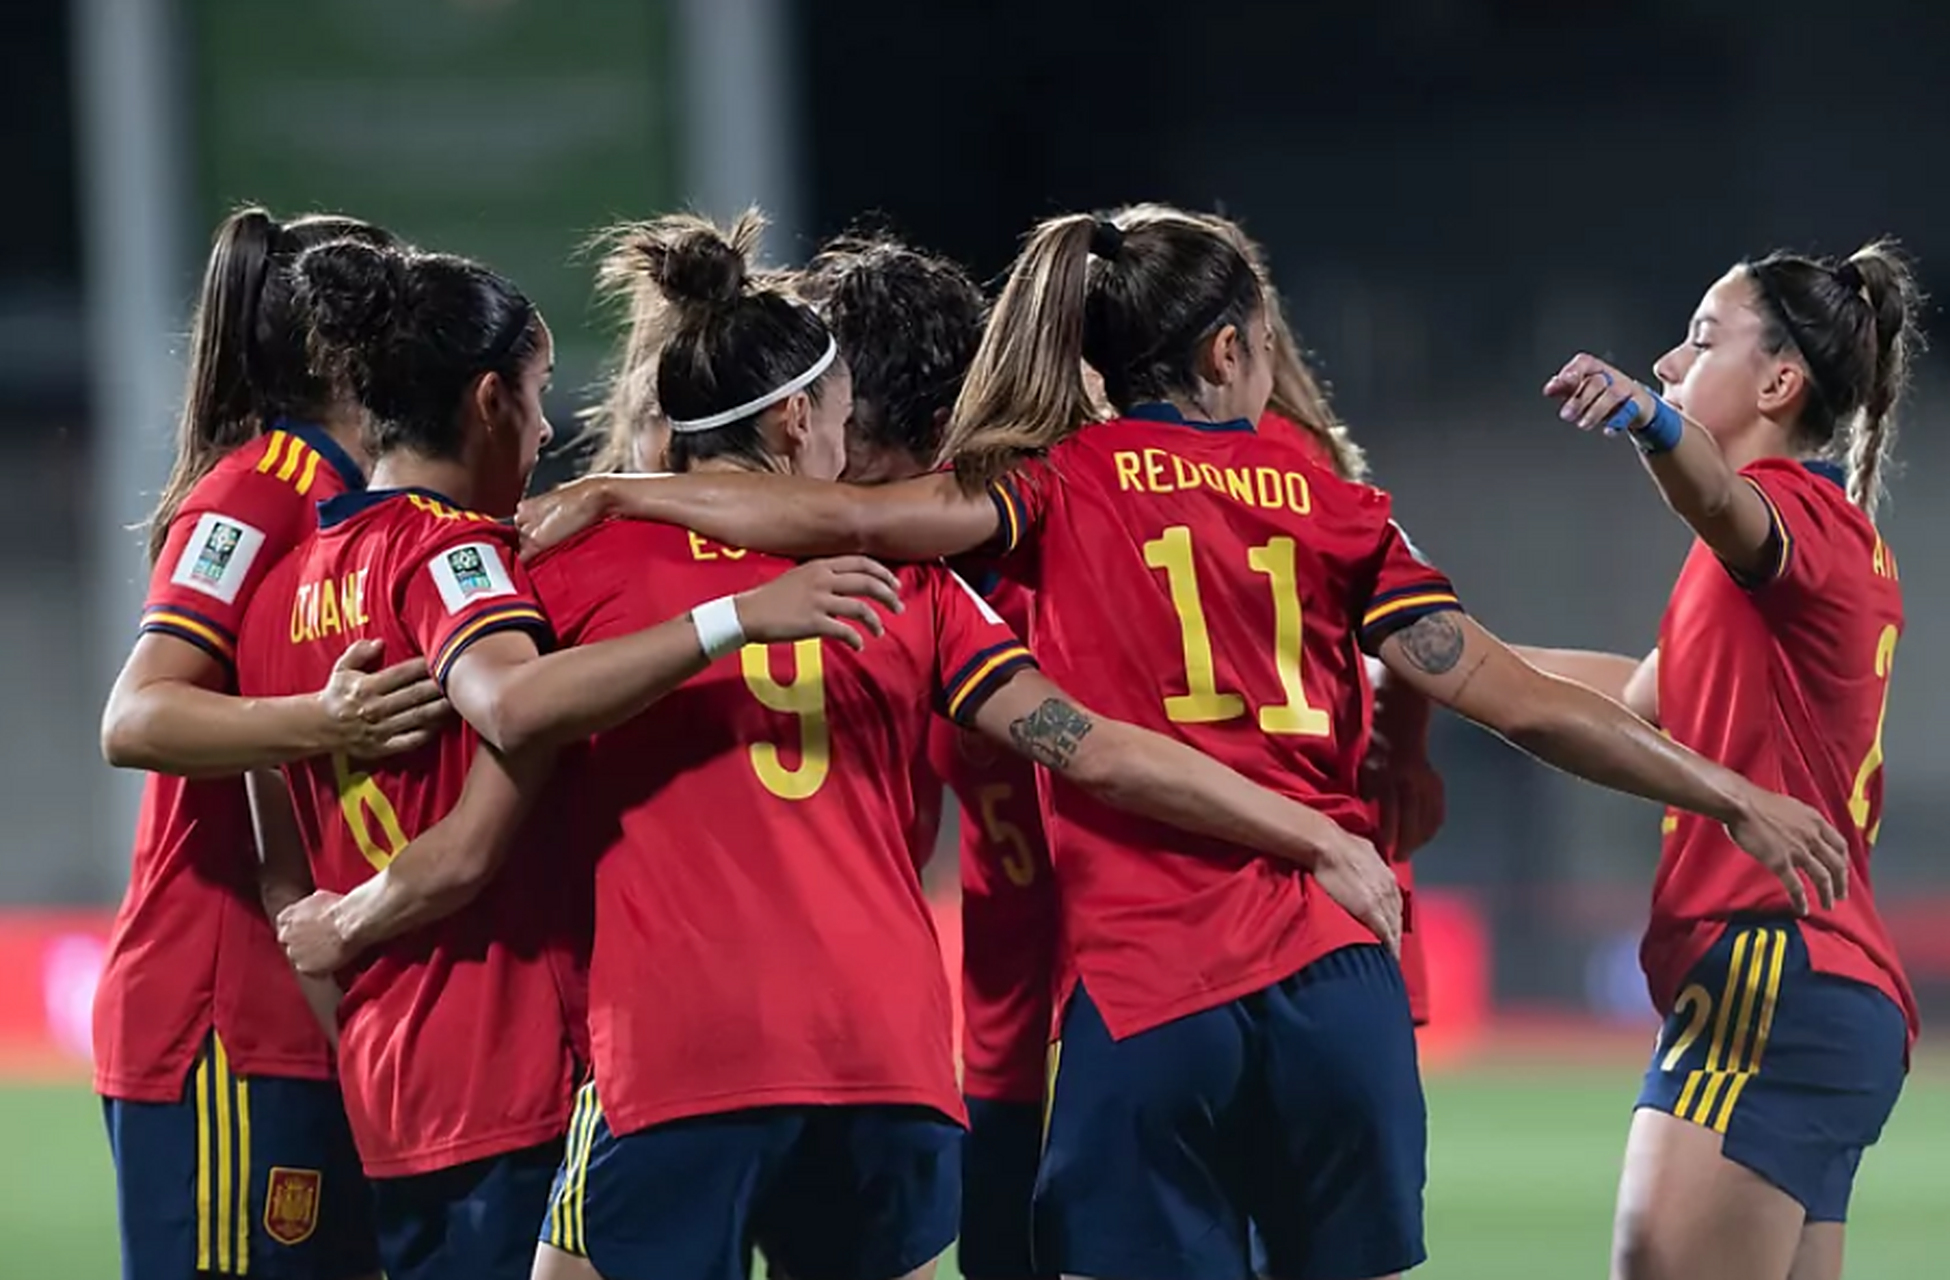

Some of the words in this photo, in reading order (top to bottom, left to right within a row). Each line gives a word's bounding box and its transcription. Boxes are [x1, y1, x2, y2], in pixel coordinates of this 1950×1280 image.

[1113, 448, 1311, 515] REDONDO
[1143, 526, 1330, 737] 11
[741, 638, 830, 800] 9
[977, 783, 1034, 877] 5
